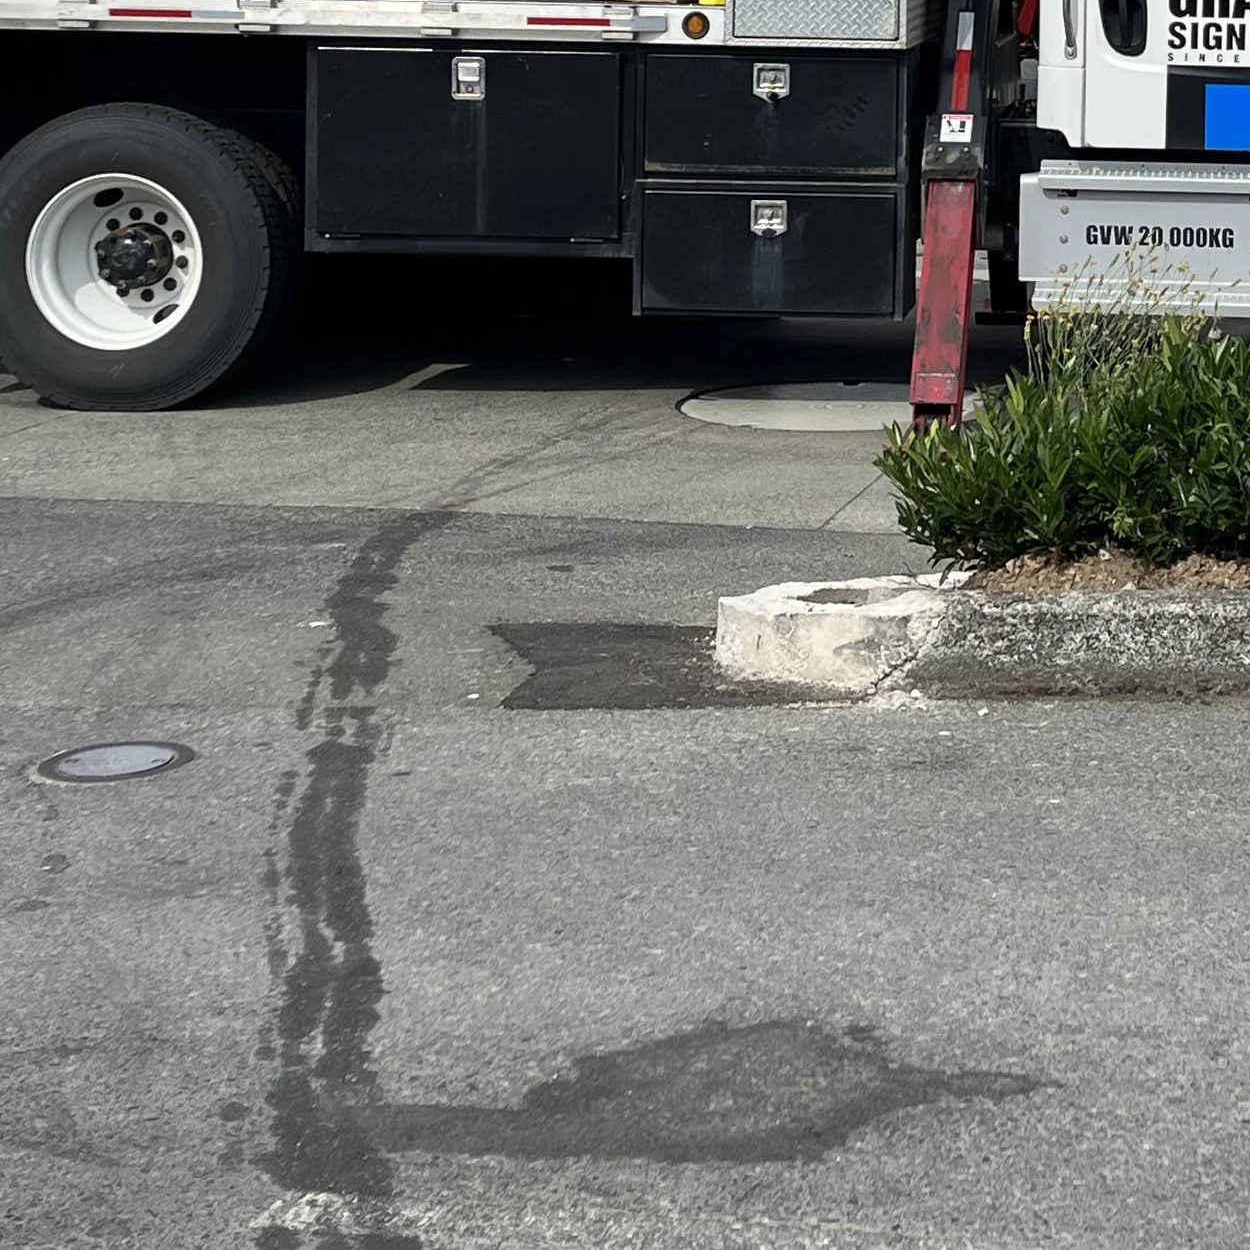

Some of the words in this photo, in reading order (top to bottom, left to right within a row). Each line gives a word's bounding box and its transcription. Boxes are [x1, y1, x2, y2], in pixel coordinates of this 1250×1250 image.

[1167, 52, 1240, 63] SINCE
[1085, 225, 1133, 246] GVW
[1169, 226, 1234, 249] 000KG
